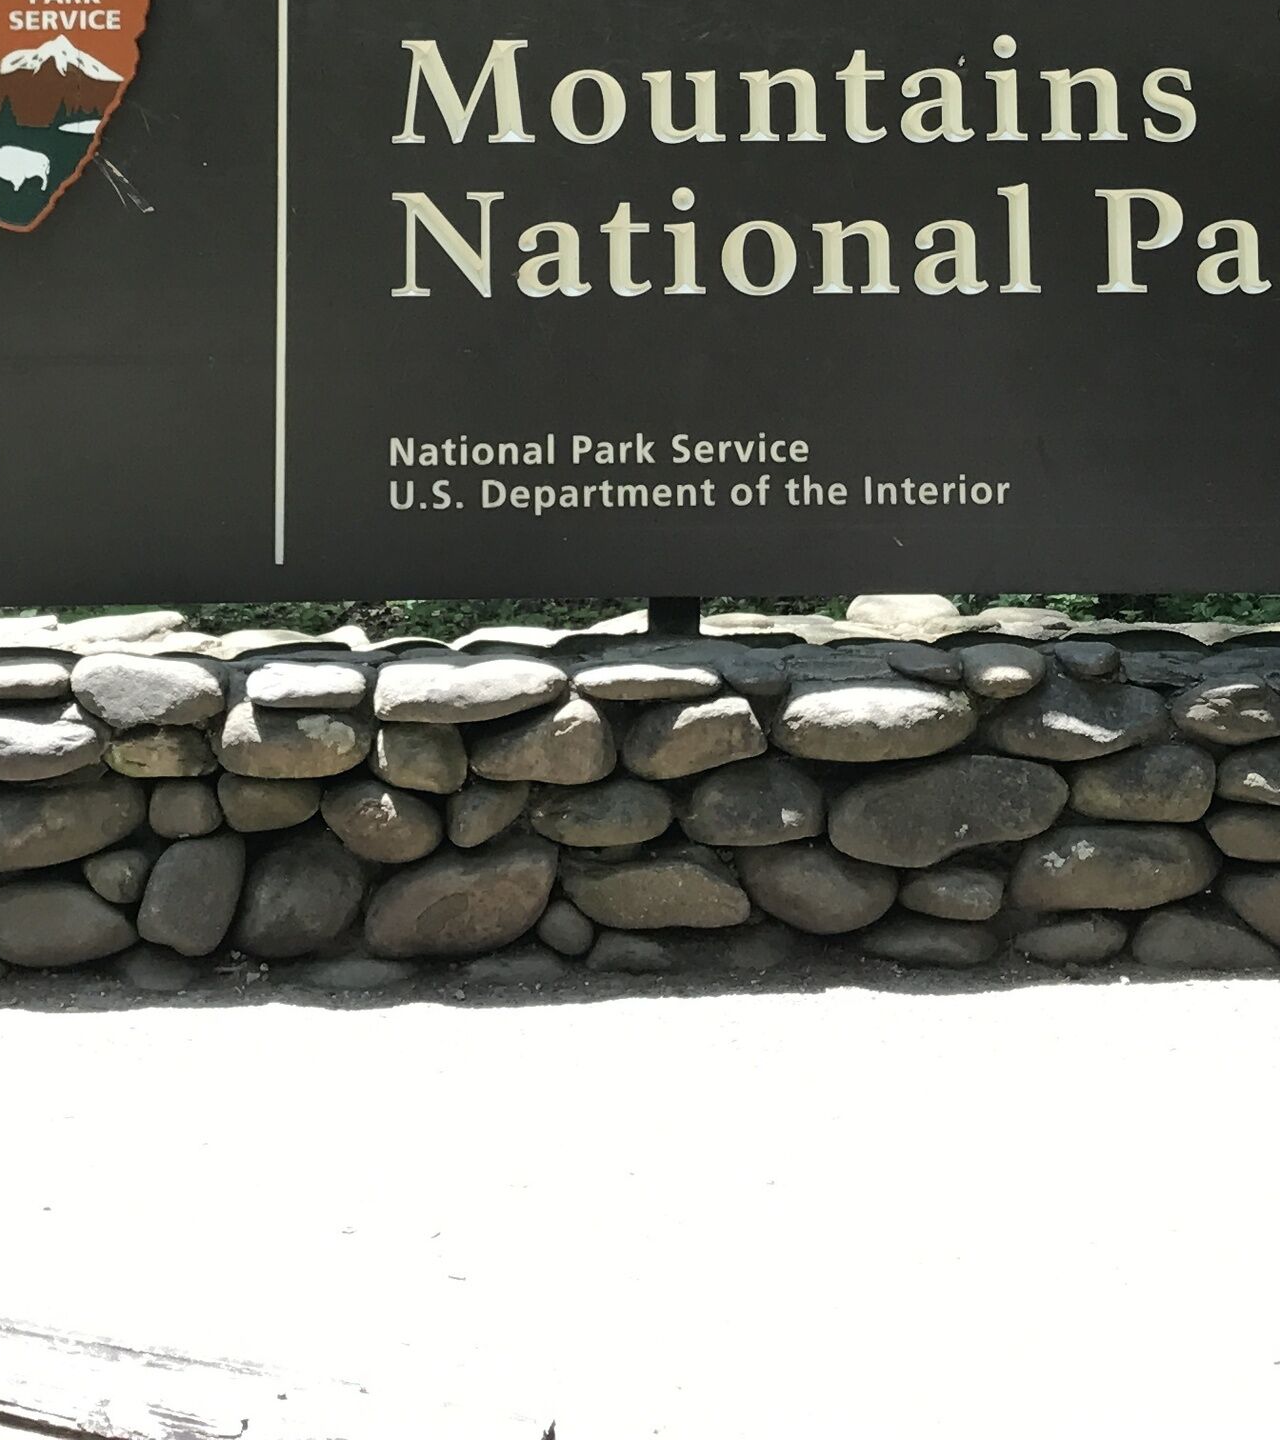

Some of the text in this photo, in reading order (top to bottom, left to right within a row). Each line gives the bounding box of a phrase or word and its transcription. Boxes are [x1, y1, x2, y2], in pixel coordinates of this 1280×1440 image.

[8, 9, 121, 31] SERVICE
[392, 34, 1196, 144] Mountains
[392, 183, 1041, 297] National
[390, 432, 809, 466] National Park Service
[390, 474, 1011, 515] U.S. Department of the Interior
